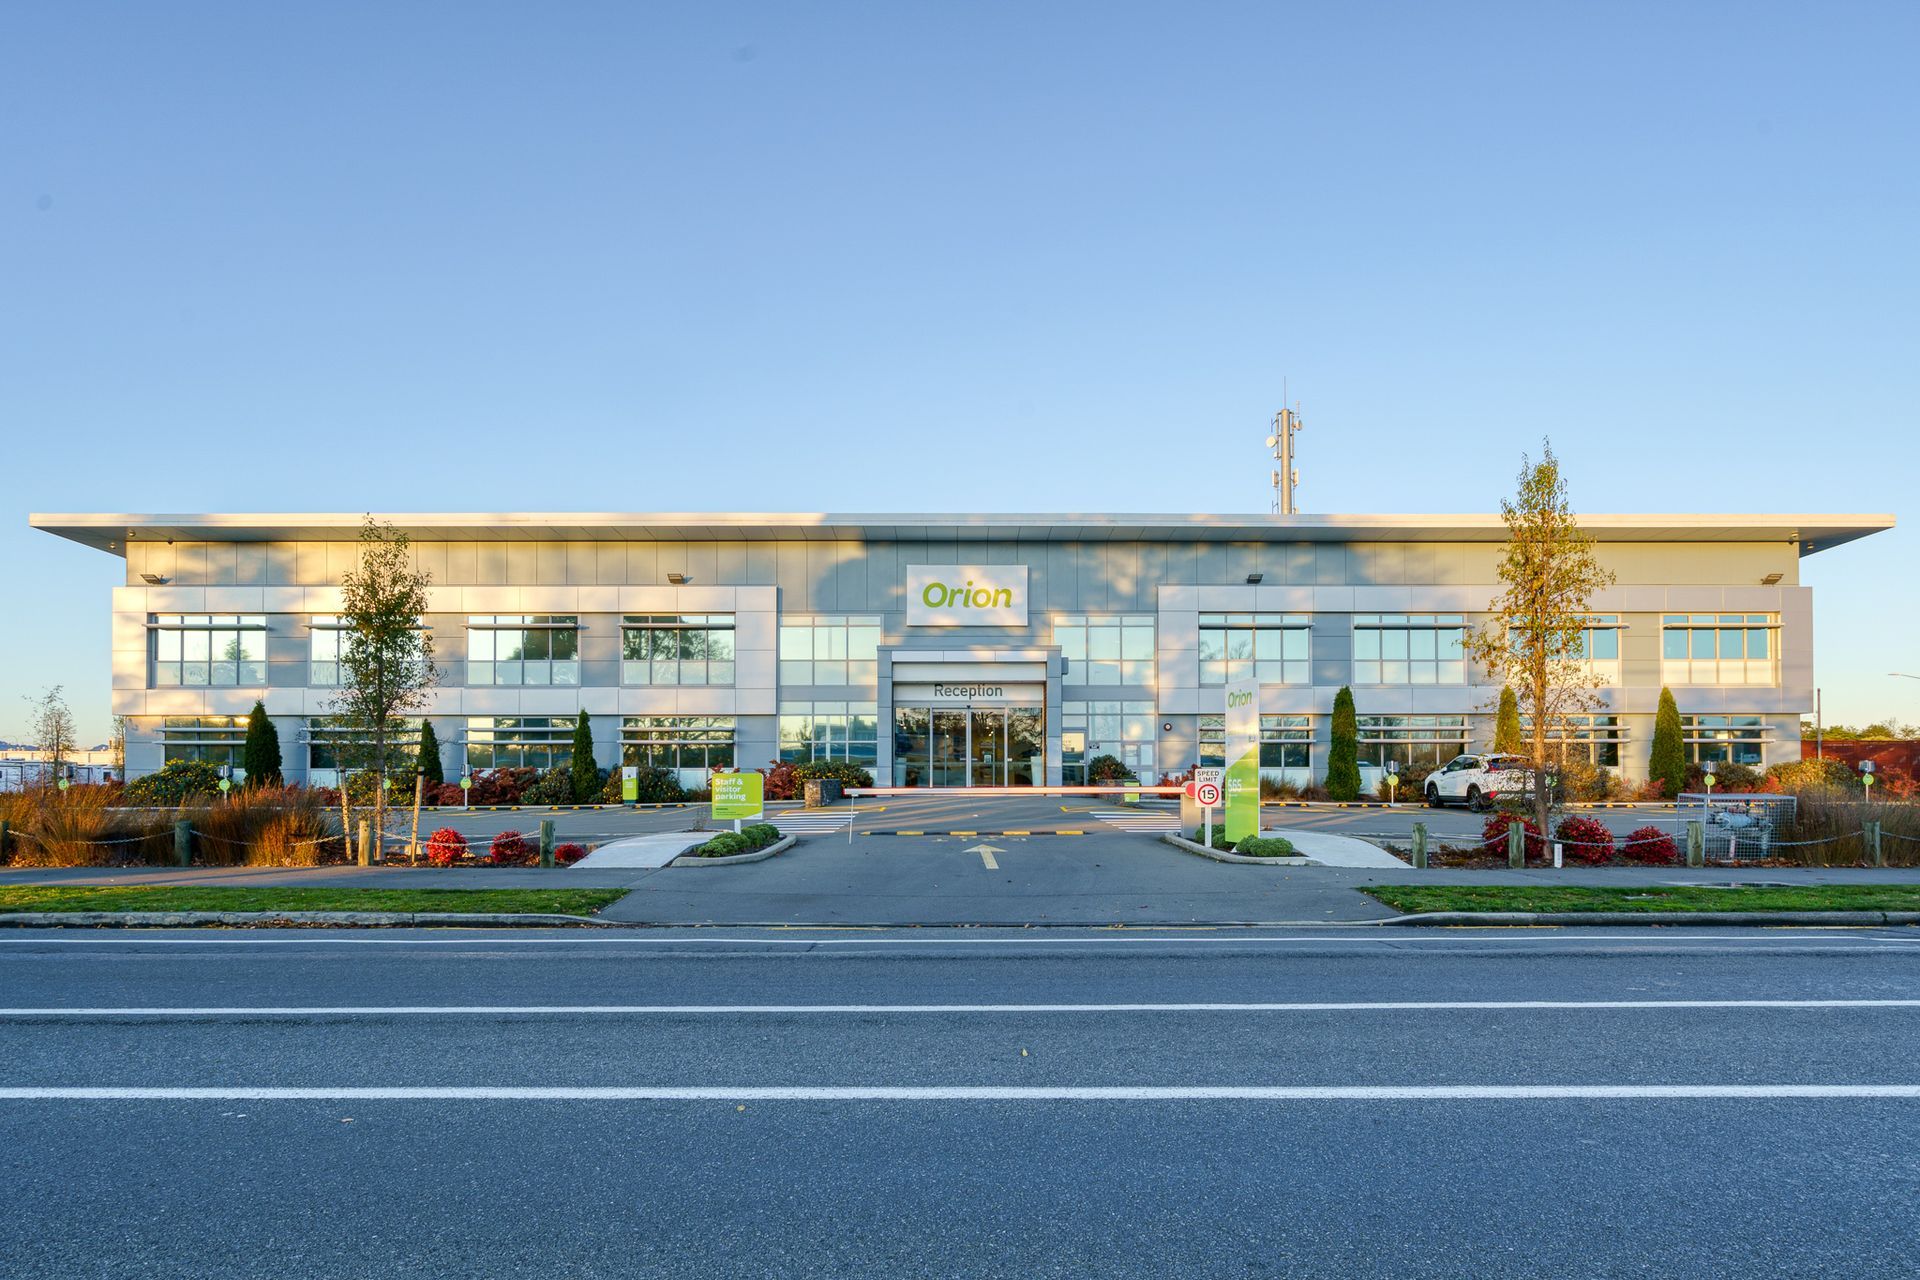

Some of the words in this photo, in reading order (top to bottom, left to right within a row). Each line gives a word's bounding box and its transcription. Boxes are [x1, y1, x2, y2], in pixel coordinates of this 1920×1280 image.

[922, 580, 1012, 608] Orion
[934, 683, 1003, 700] Reception
[1228, 688, 1253, 708] Orion
[715, 793, 746, 801] parking
[1201, 789, 1215, 800] 15
